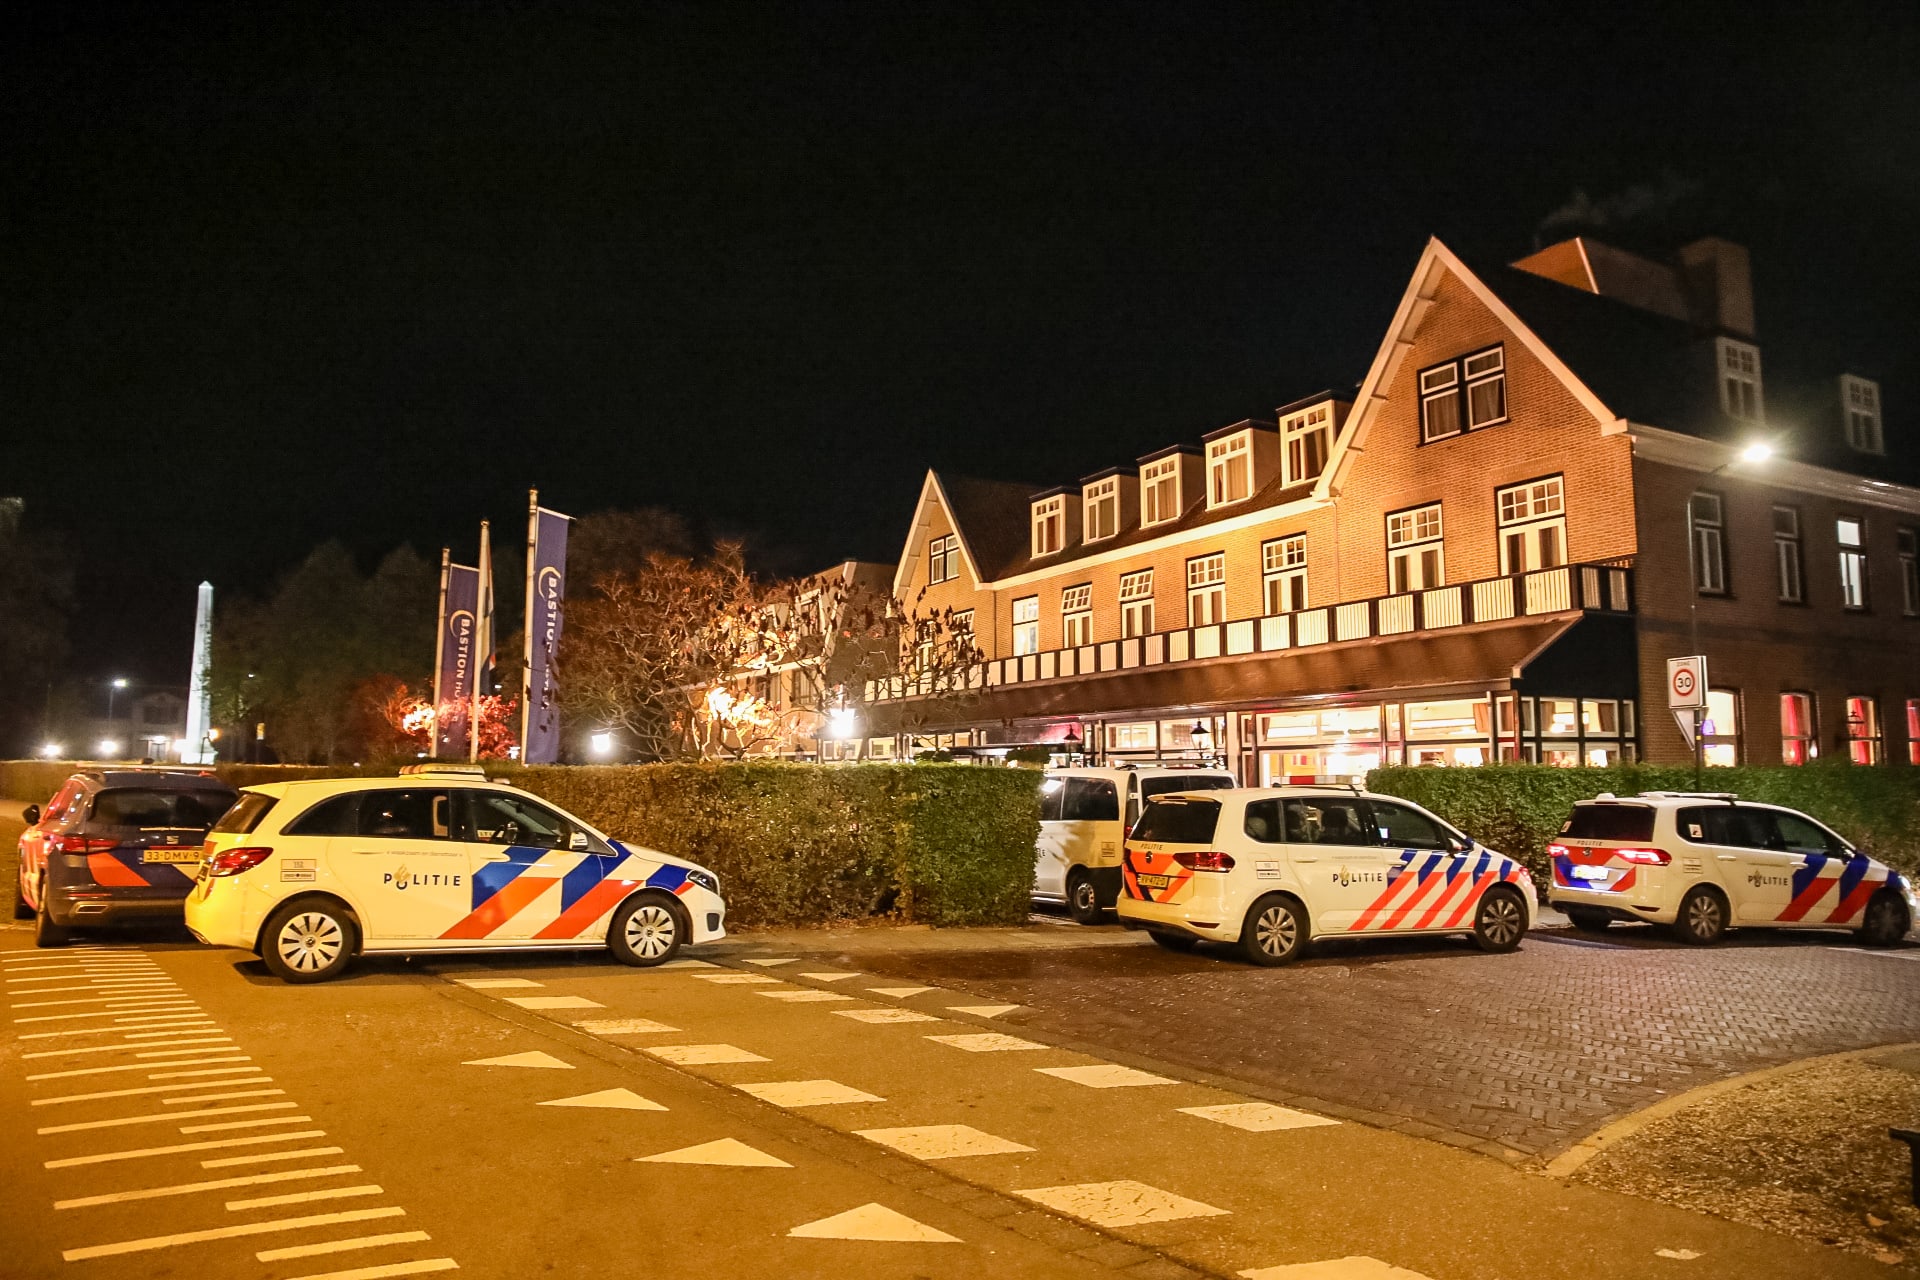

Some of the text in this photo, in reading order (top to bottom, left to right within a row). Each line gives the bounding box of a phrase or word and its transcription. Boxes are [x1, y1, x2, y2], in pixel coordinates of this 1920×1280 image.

[456, 618, 471, 679] BASTION
[1677, 677, 1692, 688] 30
[1140, 843, 1164, 851] POLITIE
[146, 851, 200, 861] 33-DMV-9
[383, 871, 462, 890] POLITIE
[1332, 871, 1383, 887] POLITIE
[1747, 873, 1789, 888] POLITIE
